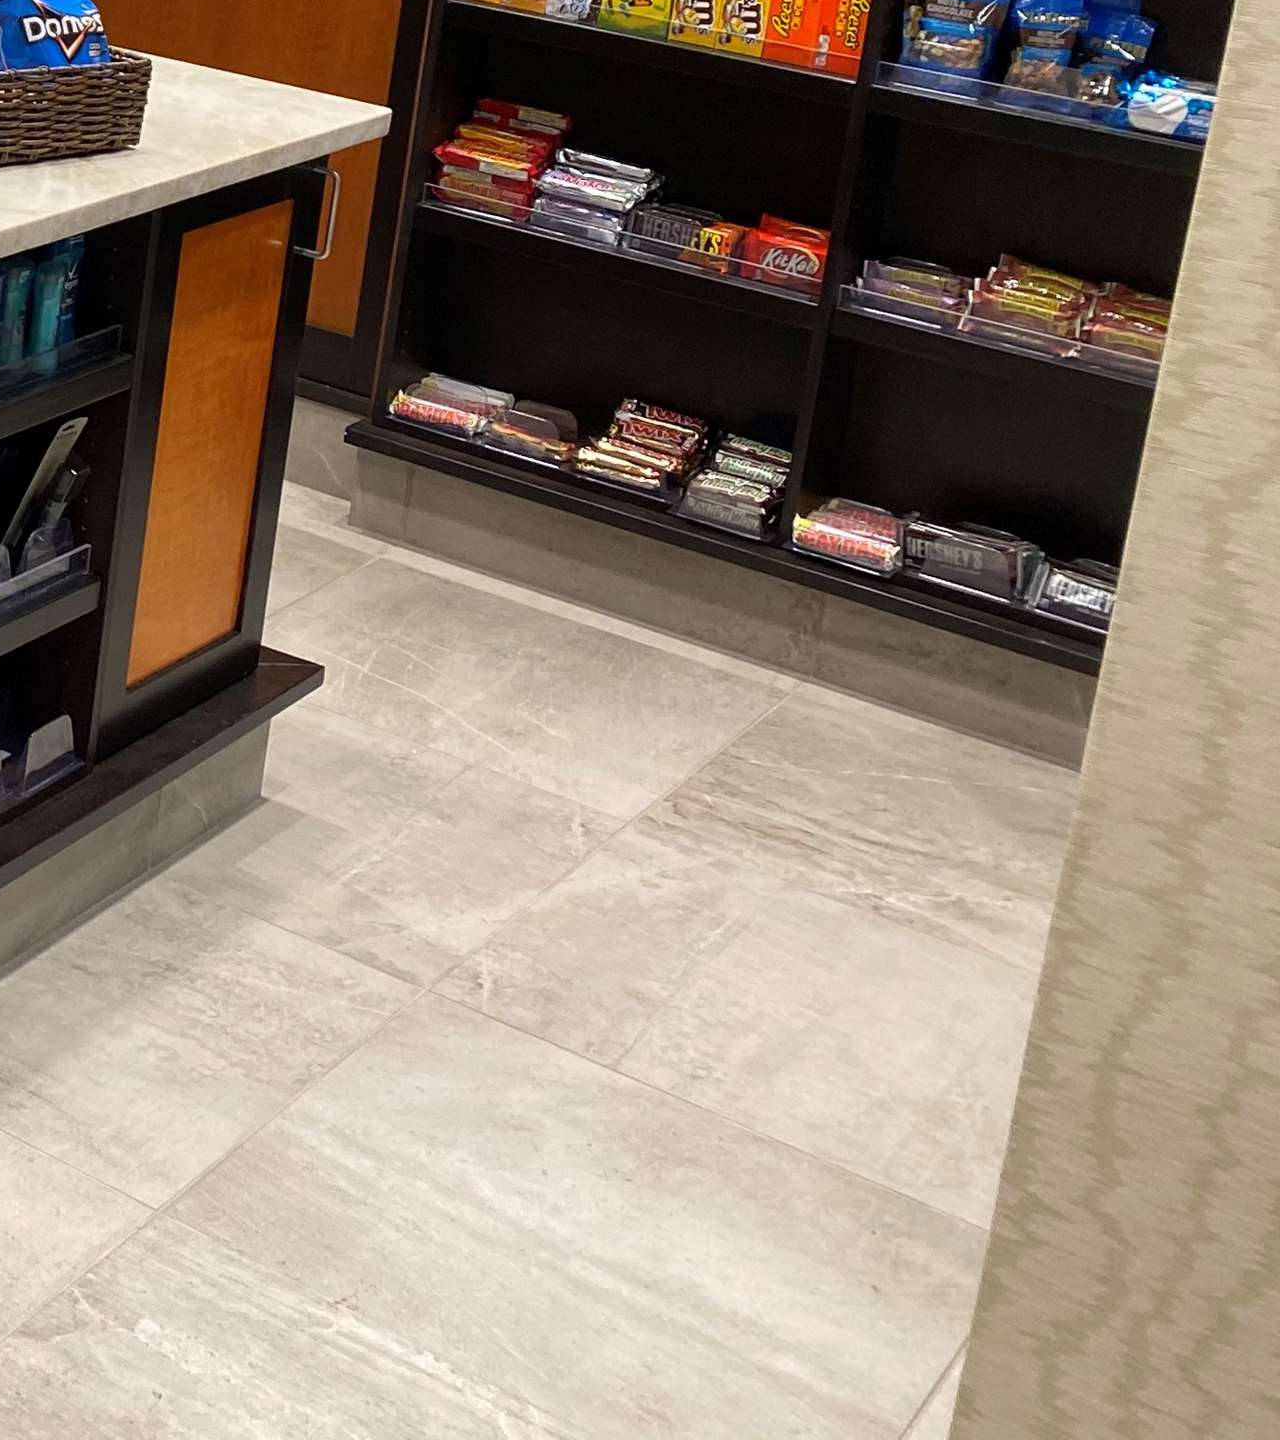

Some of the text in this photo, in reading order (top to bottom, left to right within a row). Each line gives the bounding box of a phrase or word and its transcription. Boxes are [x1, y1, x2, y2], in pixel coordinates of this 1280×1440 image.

[642, 403, 705, 429] TWIX
[617, 419, 684, 443] TWIX
[906, 536, 983, 570] HERSHEY'S
